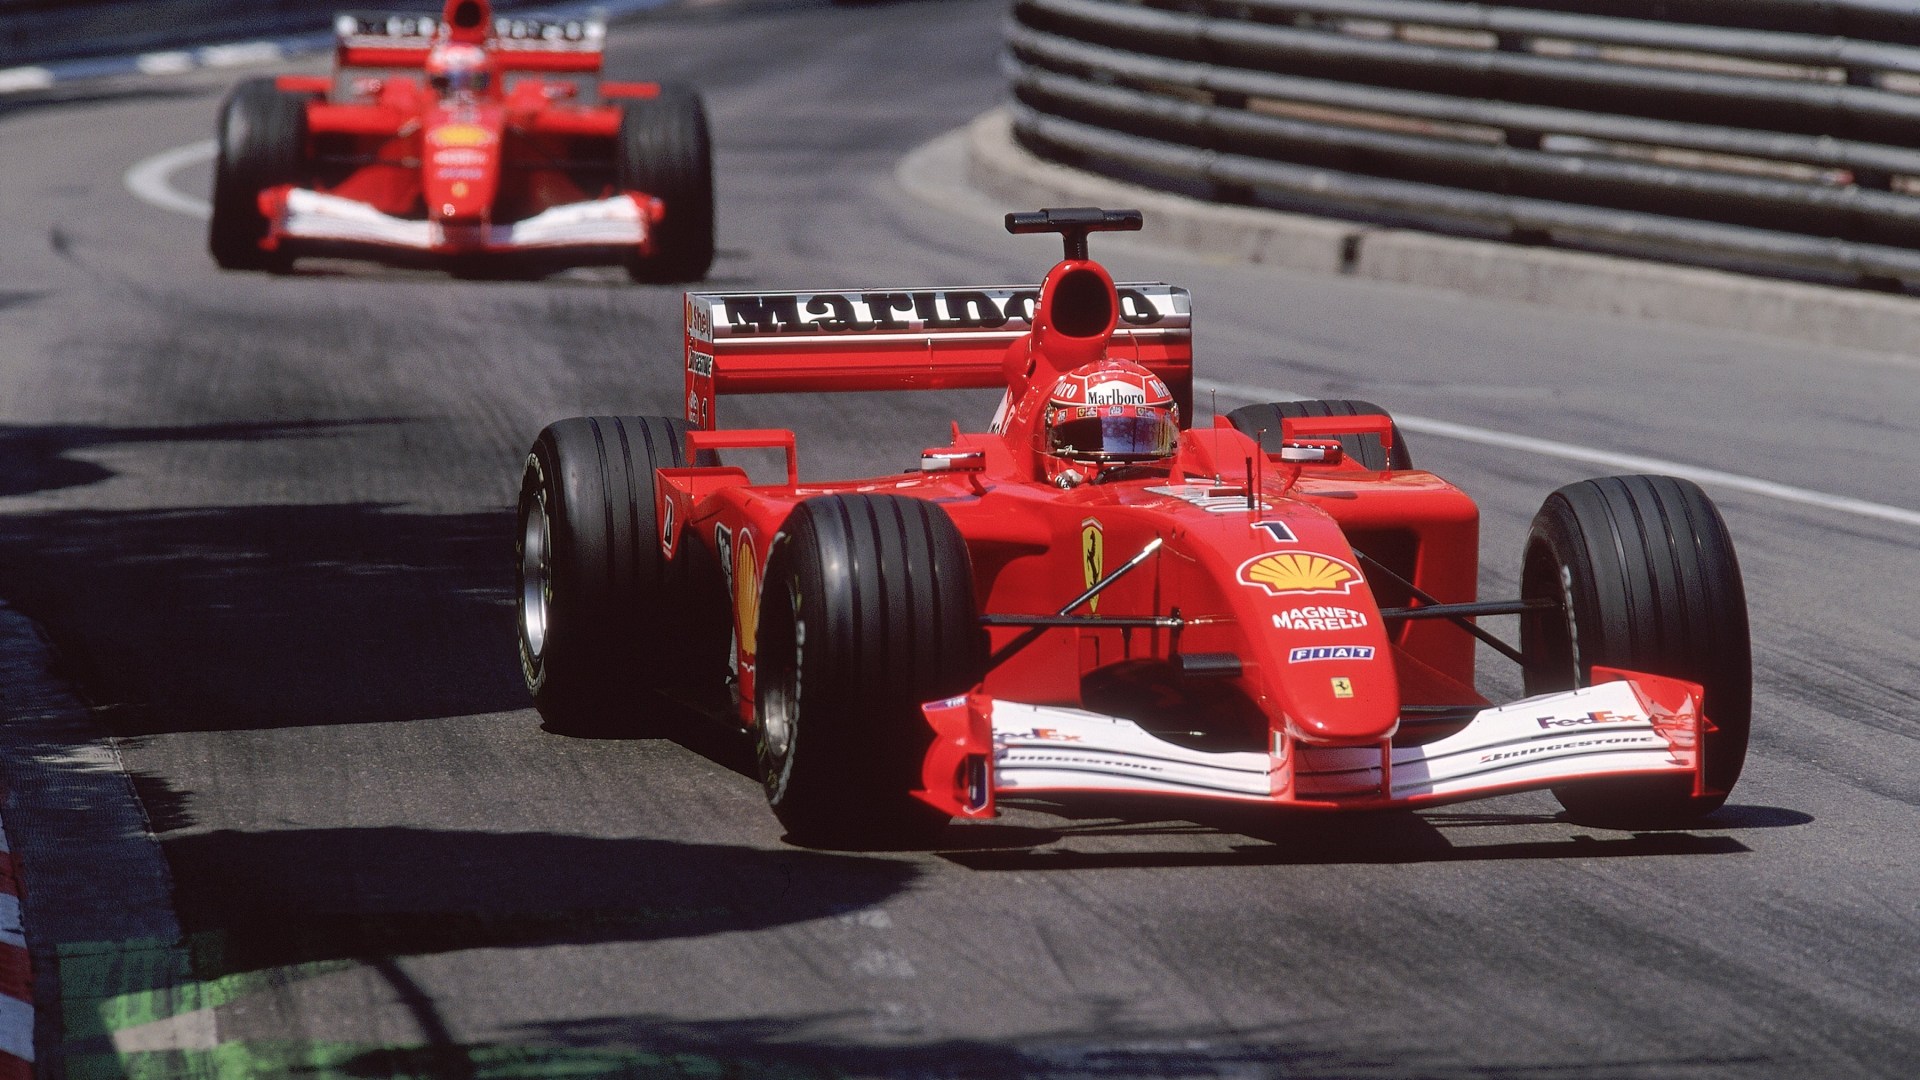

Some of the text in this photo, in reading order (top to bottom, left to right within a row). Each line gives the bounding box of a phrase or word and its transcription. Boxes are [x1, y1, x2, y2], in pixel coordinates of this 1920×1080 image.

[1088, 388, 1144, 406] Marlboro
[1250, 520, 1298, 543] 1
[1272, 606, 1368, 622] MAGNETI
[1272, 615, 1368, 631] MARELLI
[1294, 647, 1371, 662] FIAT
[1536, 710, 1643, 730] FedEx
